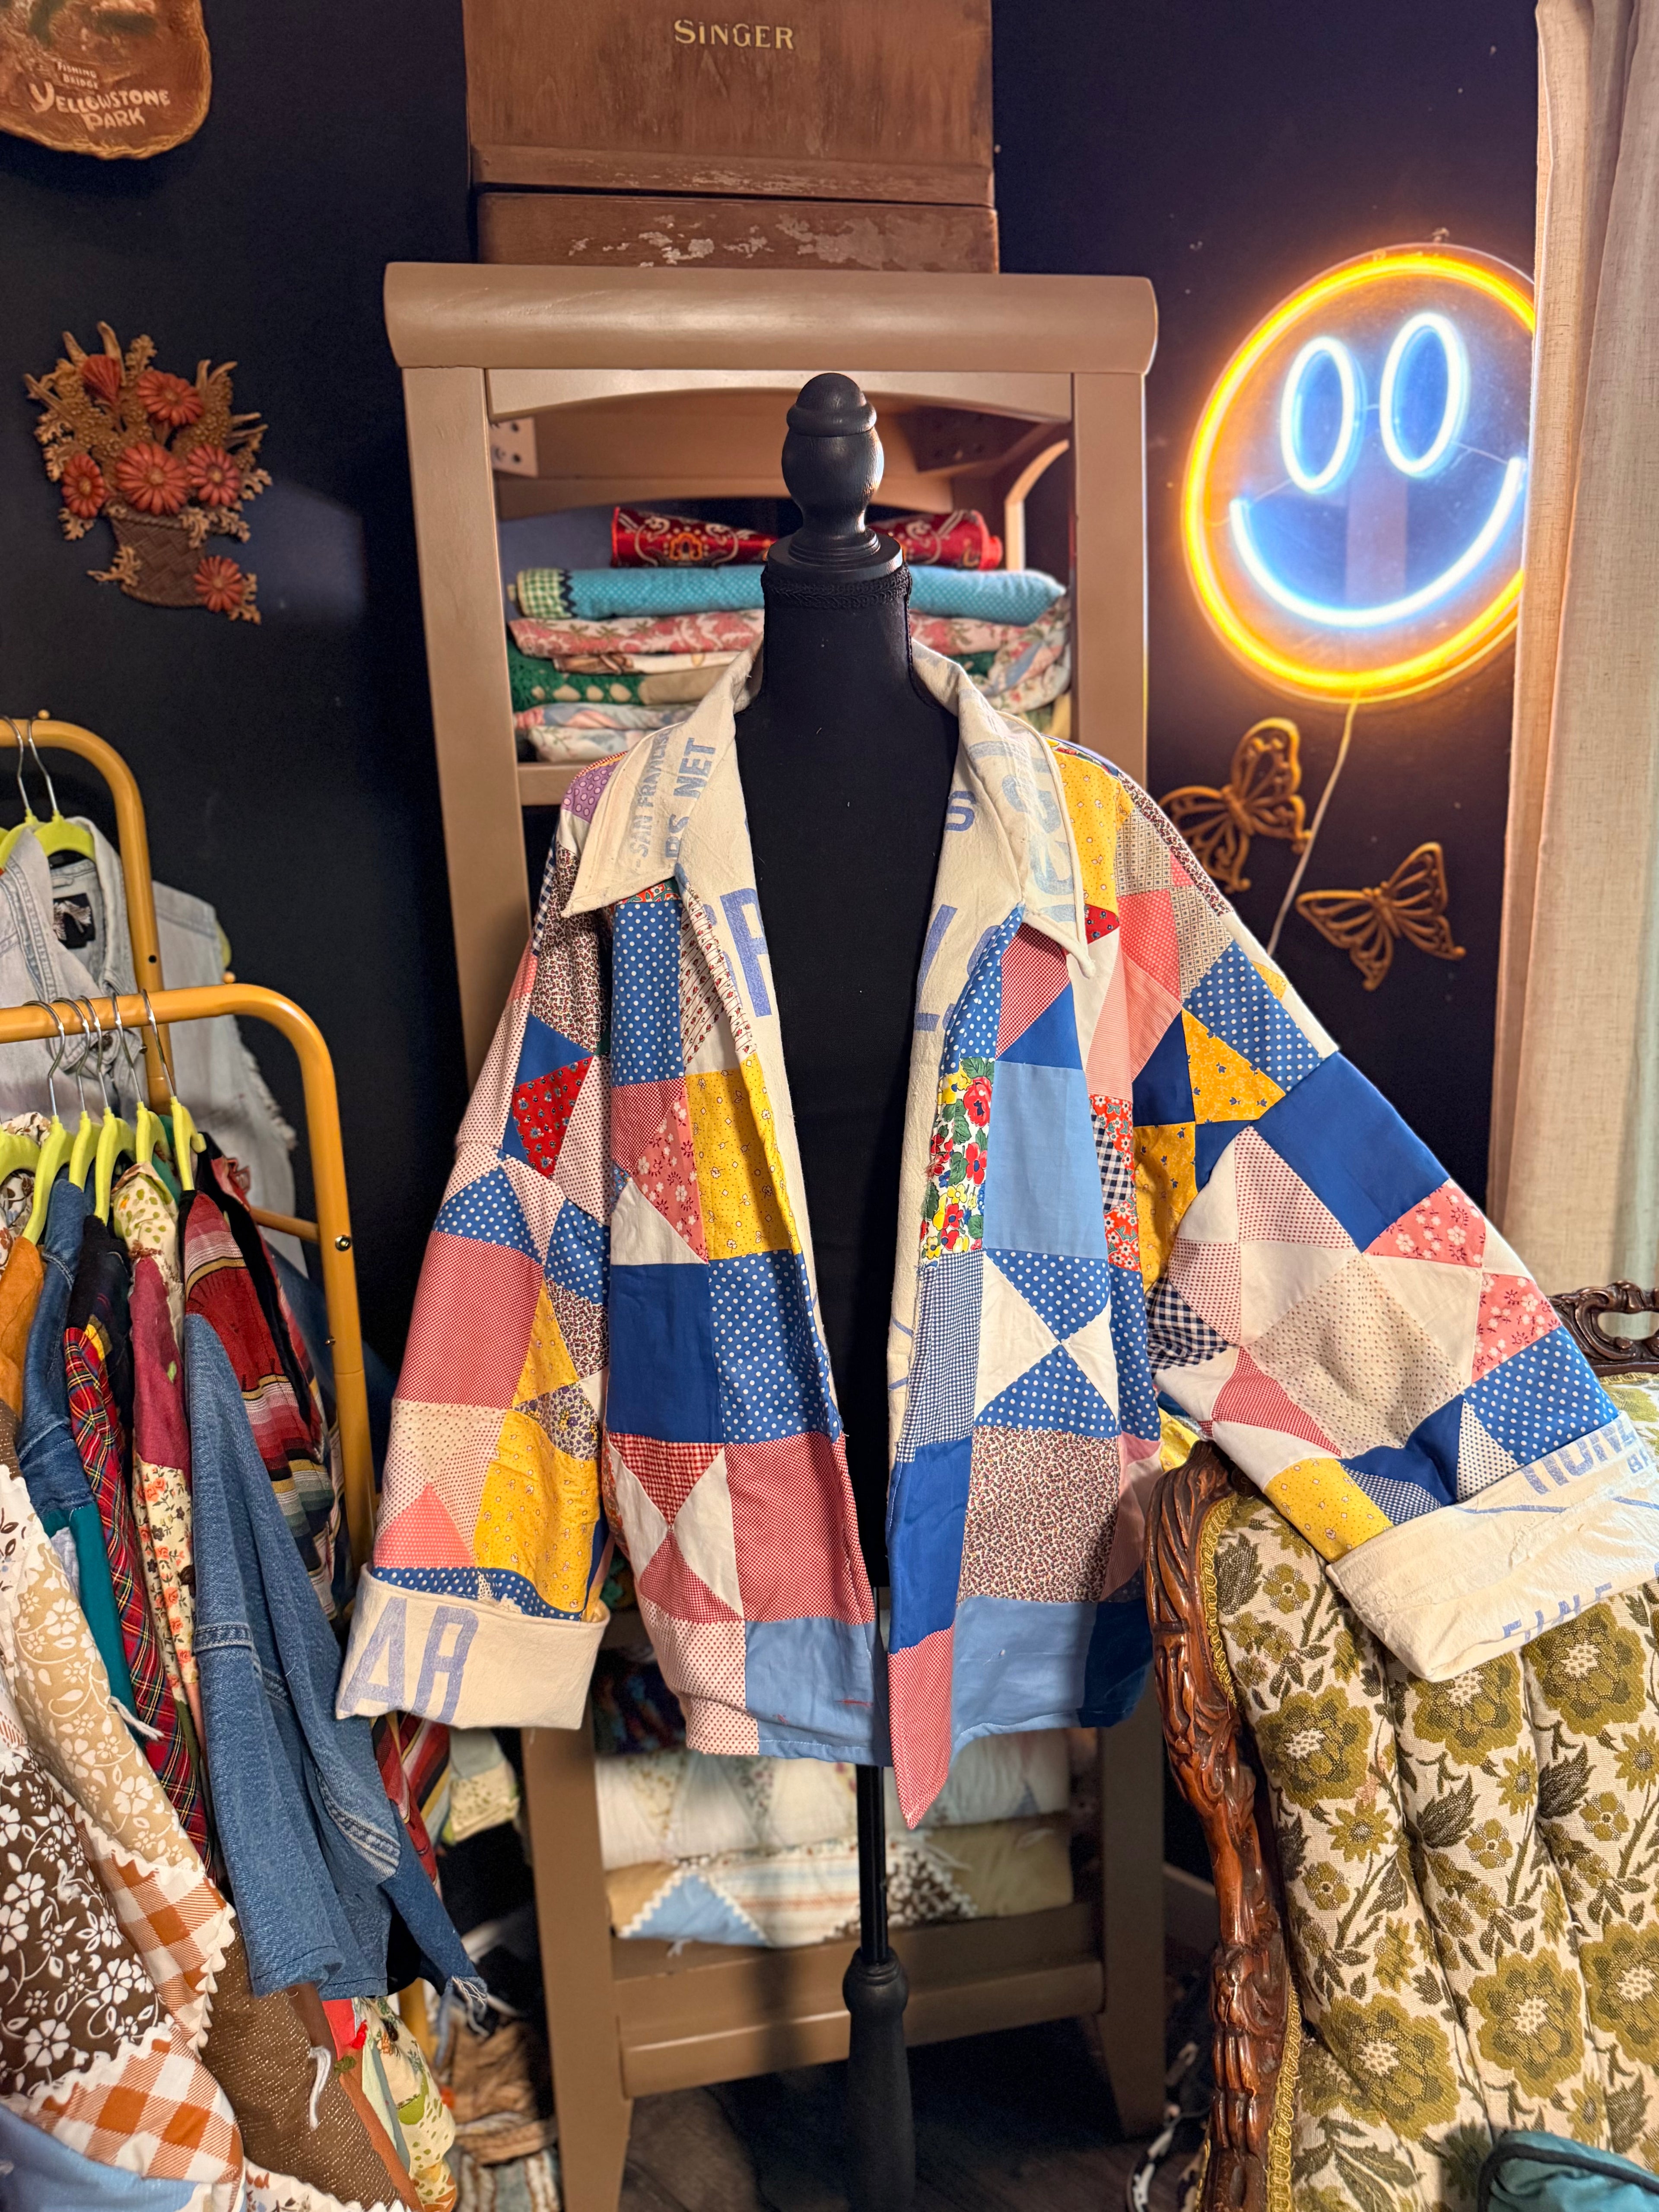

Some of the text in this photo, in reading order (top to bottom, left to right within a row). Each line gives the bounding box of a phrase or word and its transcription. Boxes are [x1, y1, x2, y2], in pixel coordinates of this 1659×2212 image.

[674, 19, 794, 50] SINGER
[57, 62, 97, 79] FISHING
[63, 73, 99, 89] BRIDGE
[29, 81, 171, 113] YELLOWSTONE
[80, 108, 146, 132] PARK
[673, 737, 716, 800] NET
